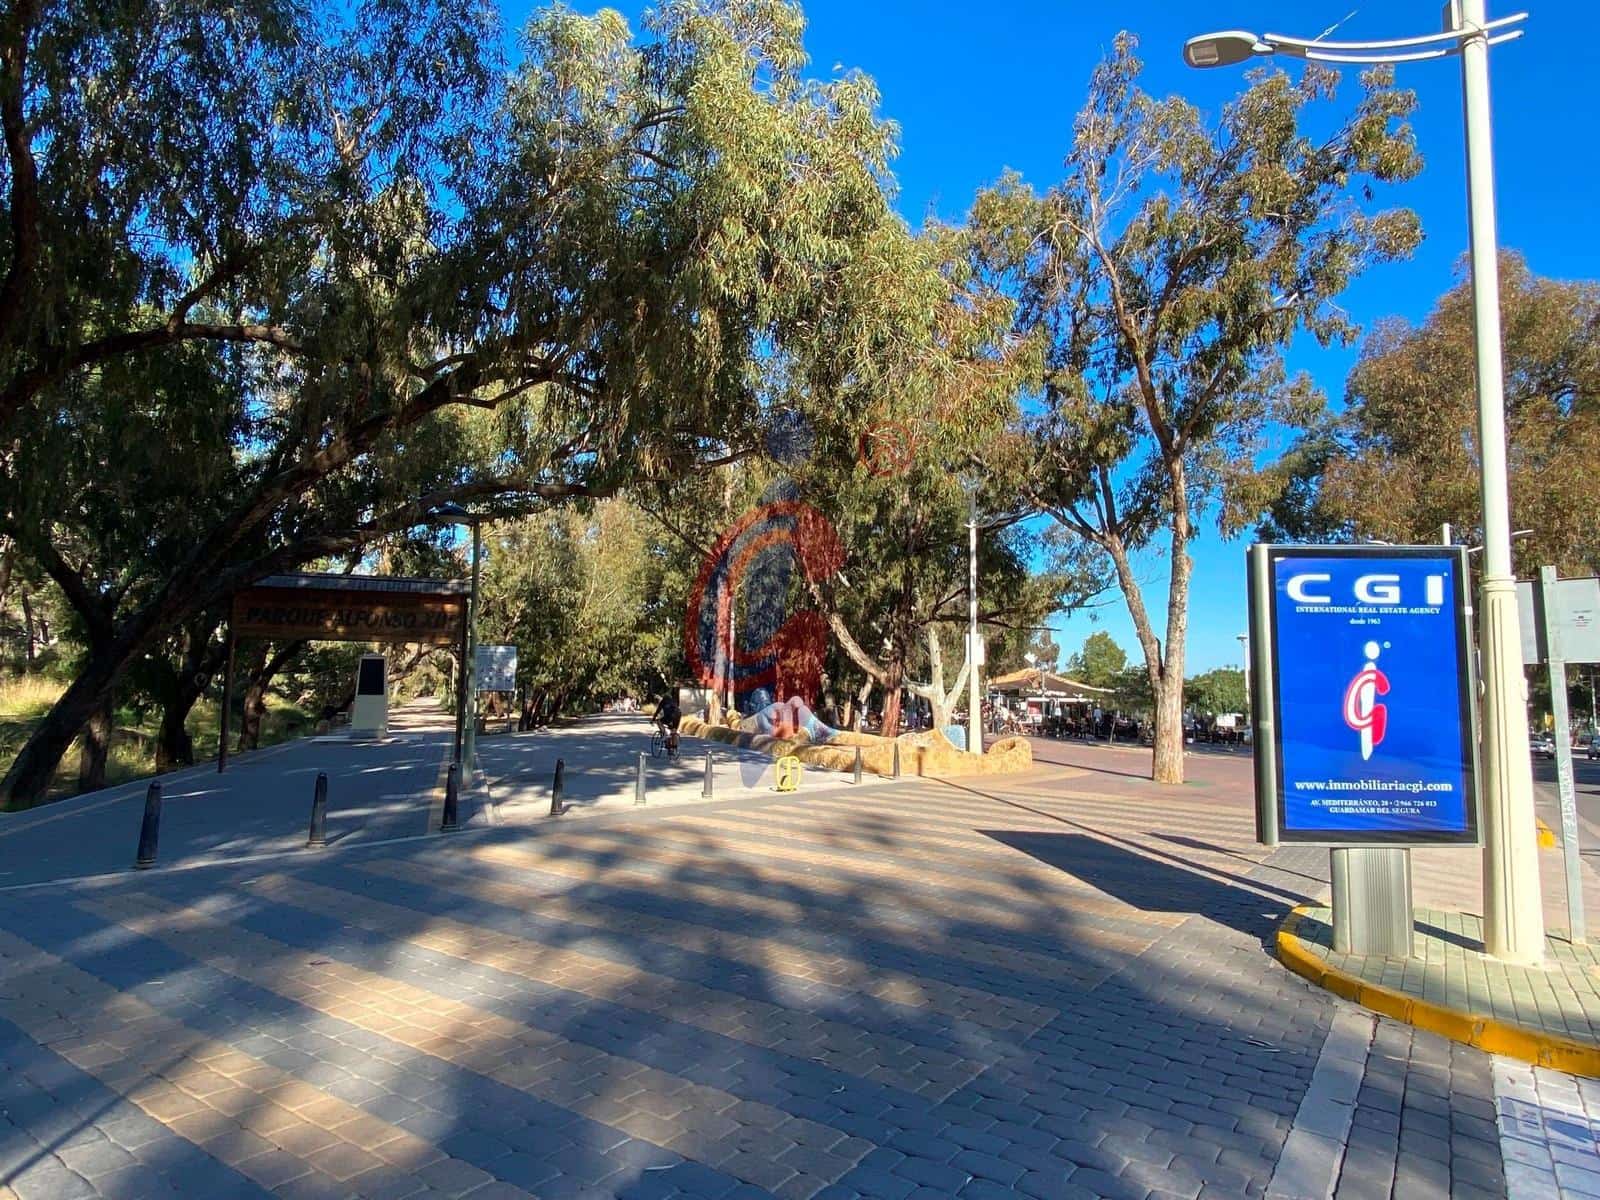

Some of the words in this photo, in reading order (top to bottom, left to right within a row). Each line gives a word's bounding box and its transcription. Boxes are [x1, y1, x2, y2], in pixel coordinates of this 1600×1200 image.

[247, 606, 327, 626] PARQUE
[333, 607, 416, 628] ALFONSO
[1295, 779, 1453, 793] www.inmobiliariacgi.com
